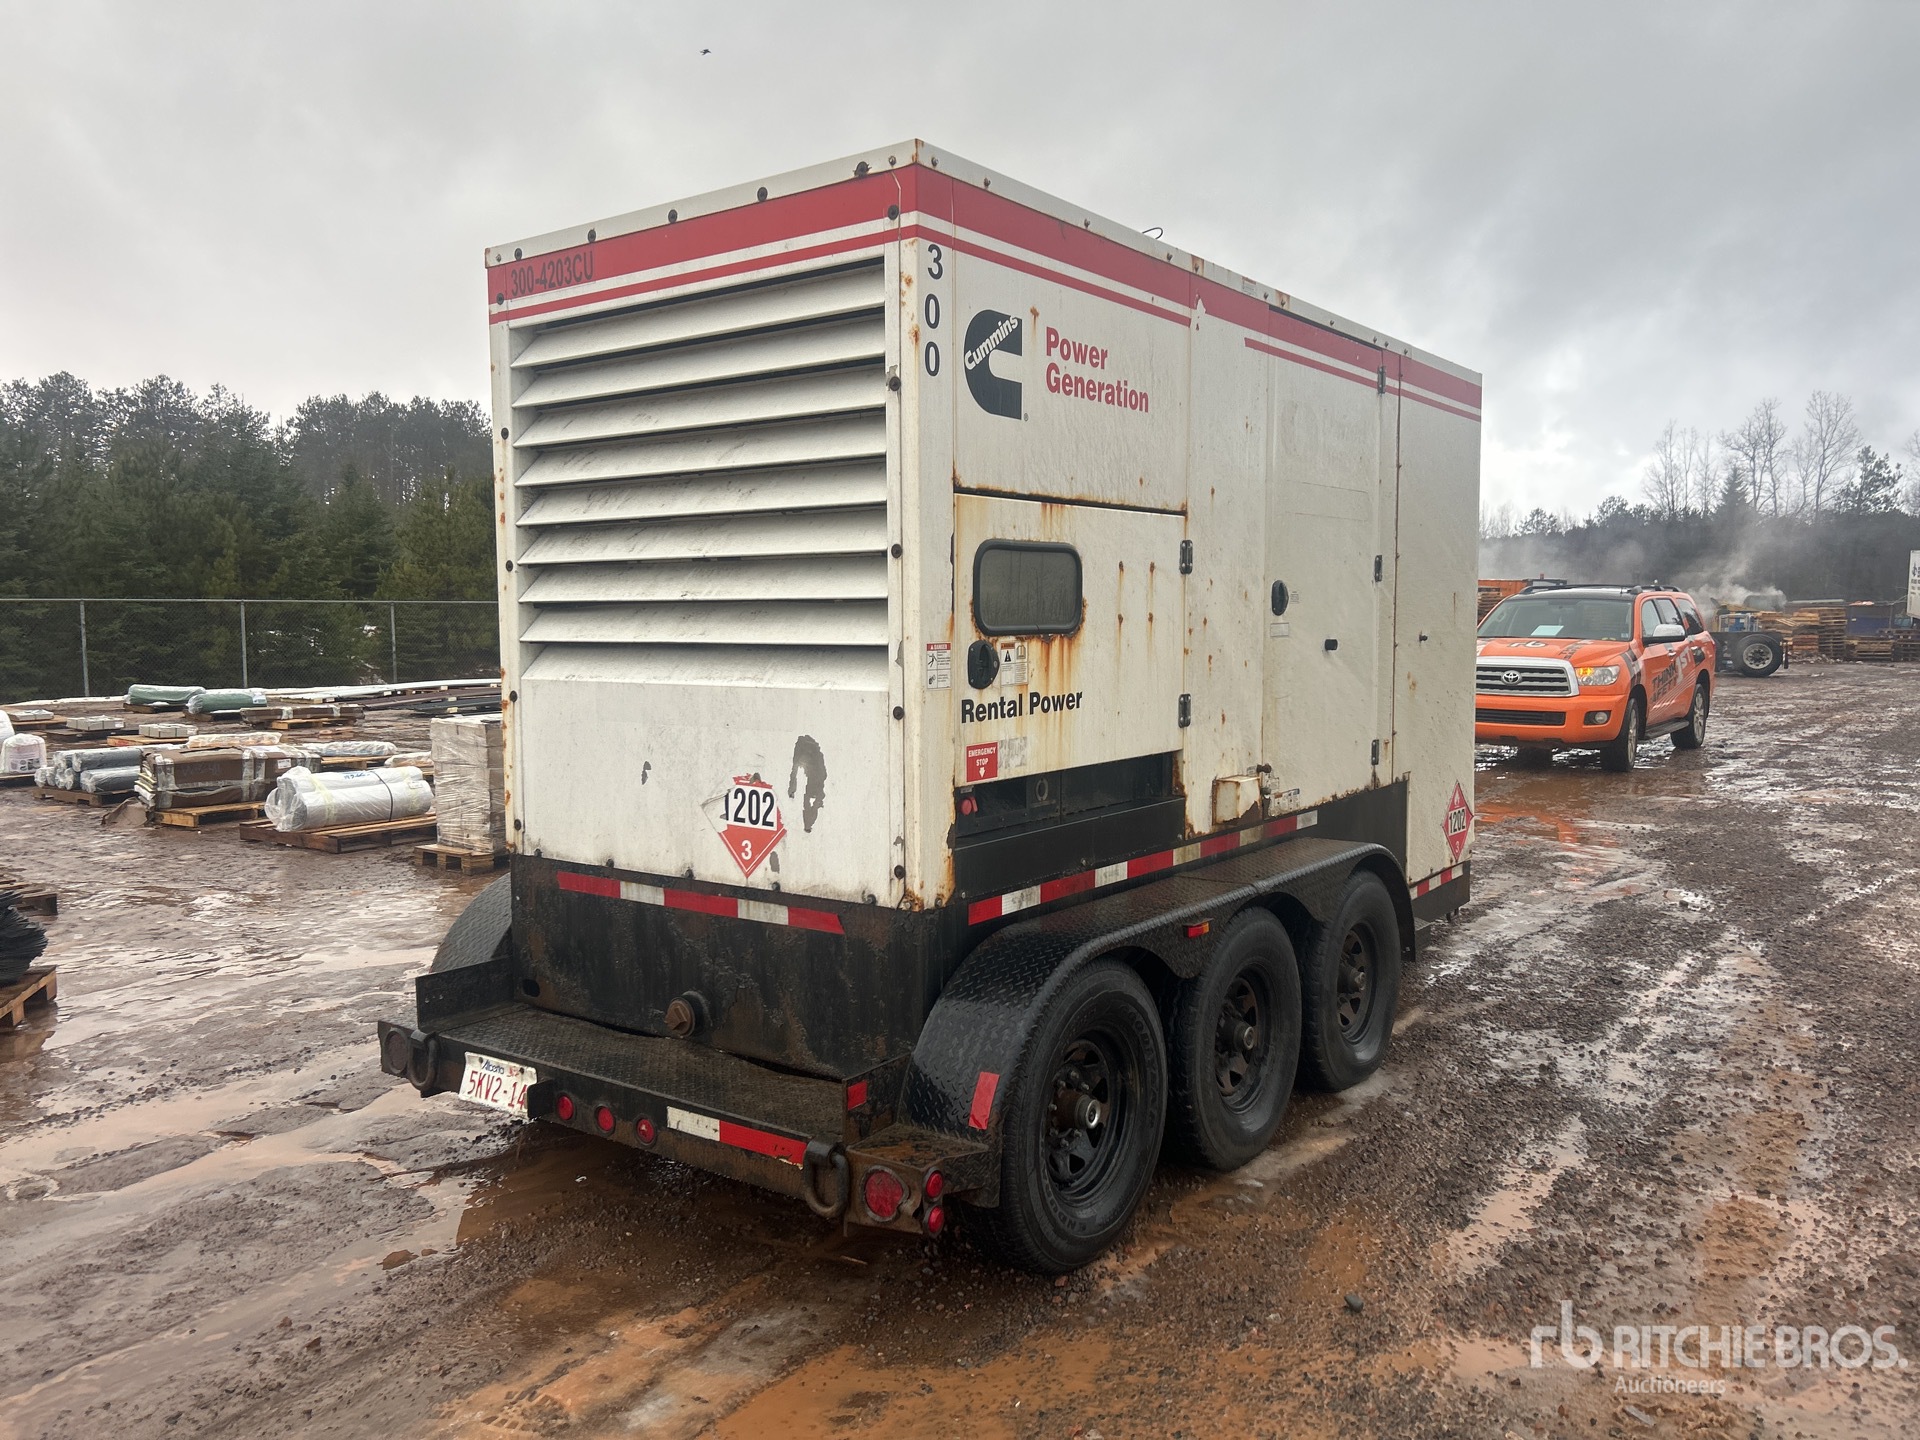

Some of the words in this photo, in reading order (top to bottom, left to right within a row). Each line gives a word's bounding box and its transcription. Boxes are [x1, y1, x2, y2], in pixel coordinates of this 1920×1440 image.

[511, 250, 594, 297] 300-4203CU
[964, 315, 1019, 371] Cummins
[1046, 326, 1108, 370] Power
[1046, 362, 1149, 413] Generation
[961, 693, 1023, 724] Rental
[1029, 691, 1083, 715] Power
[968, 746, 997, 758] EMERGENCY
[976, 758, 989, 767] STOP
[724, 787, 775, 828] 1202
[1449, 808, 1466, 834] 1202
[741, 839, 752, 860] 3
[1455, 841, 1460, 853] 3
